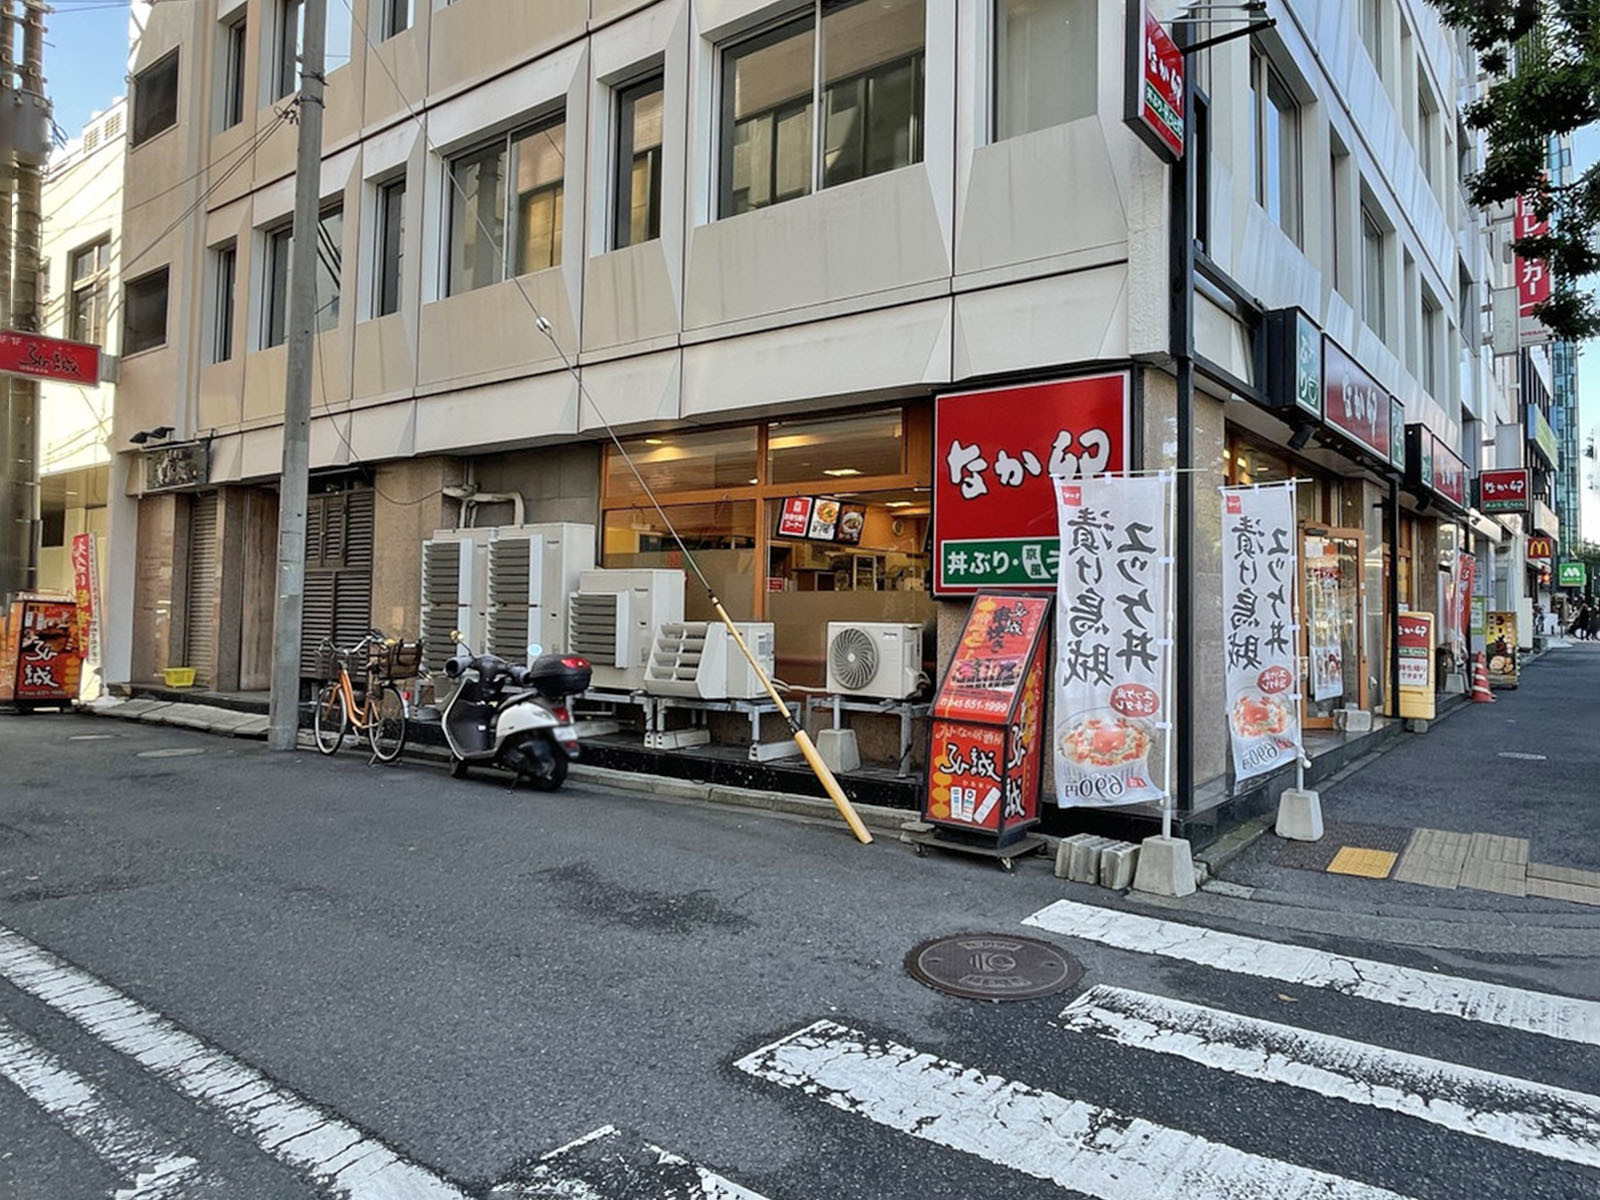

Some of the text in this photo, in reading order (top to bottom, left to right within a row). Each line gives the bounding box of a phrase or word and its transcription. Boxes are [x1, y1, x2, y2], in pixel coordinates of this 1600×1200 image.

[946, 428, 1111, 500] なか卯
[1484, 480, 1524, 494] なか卯
